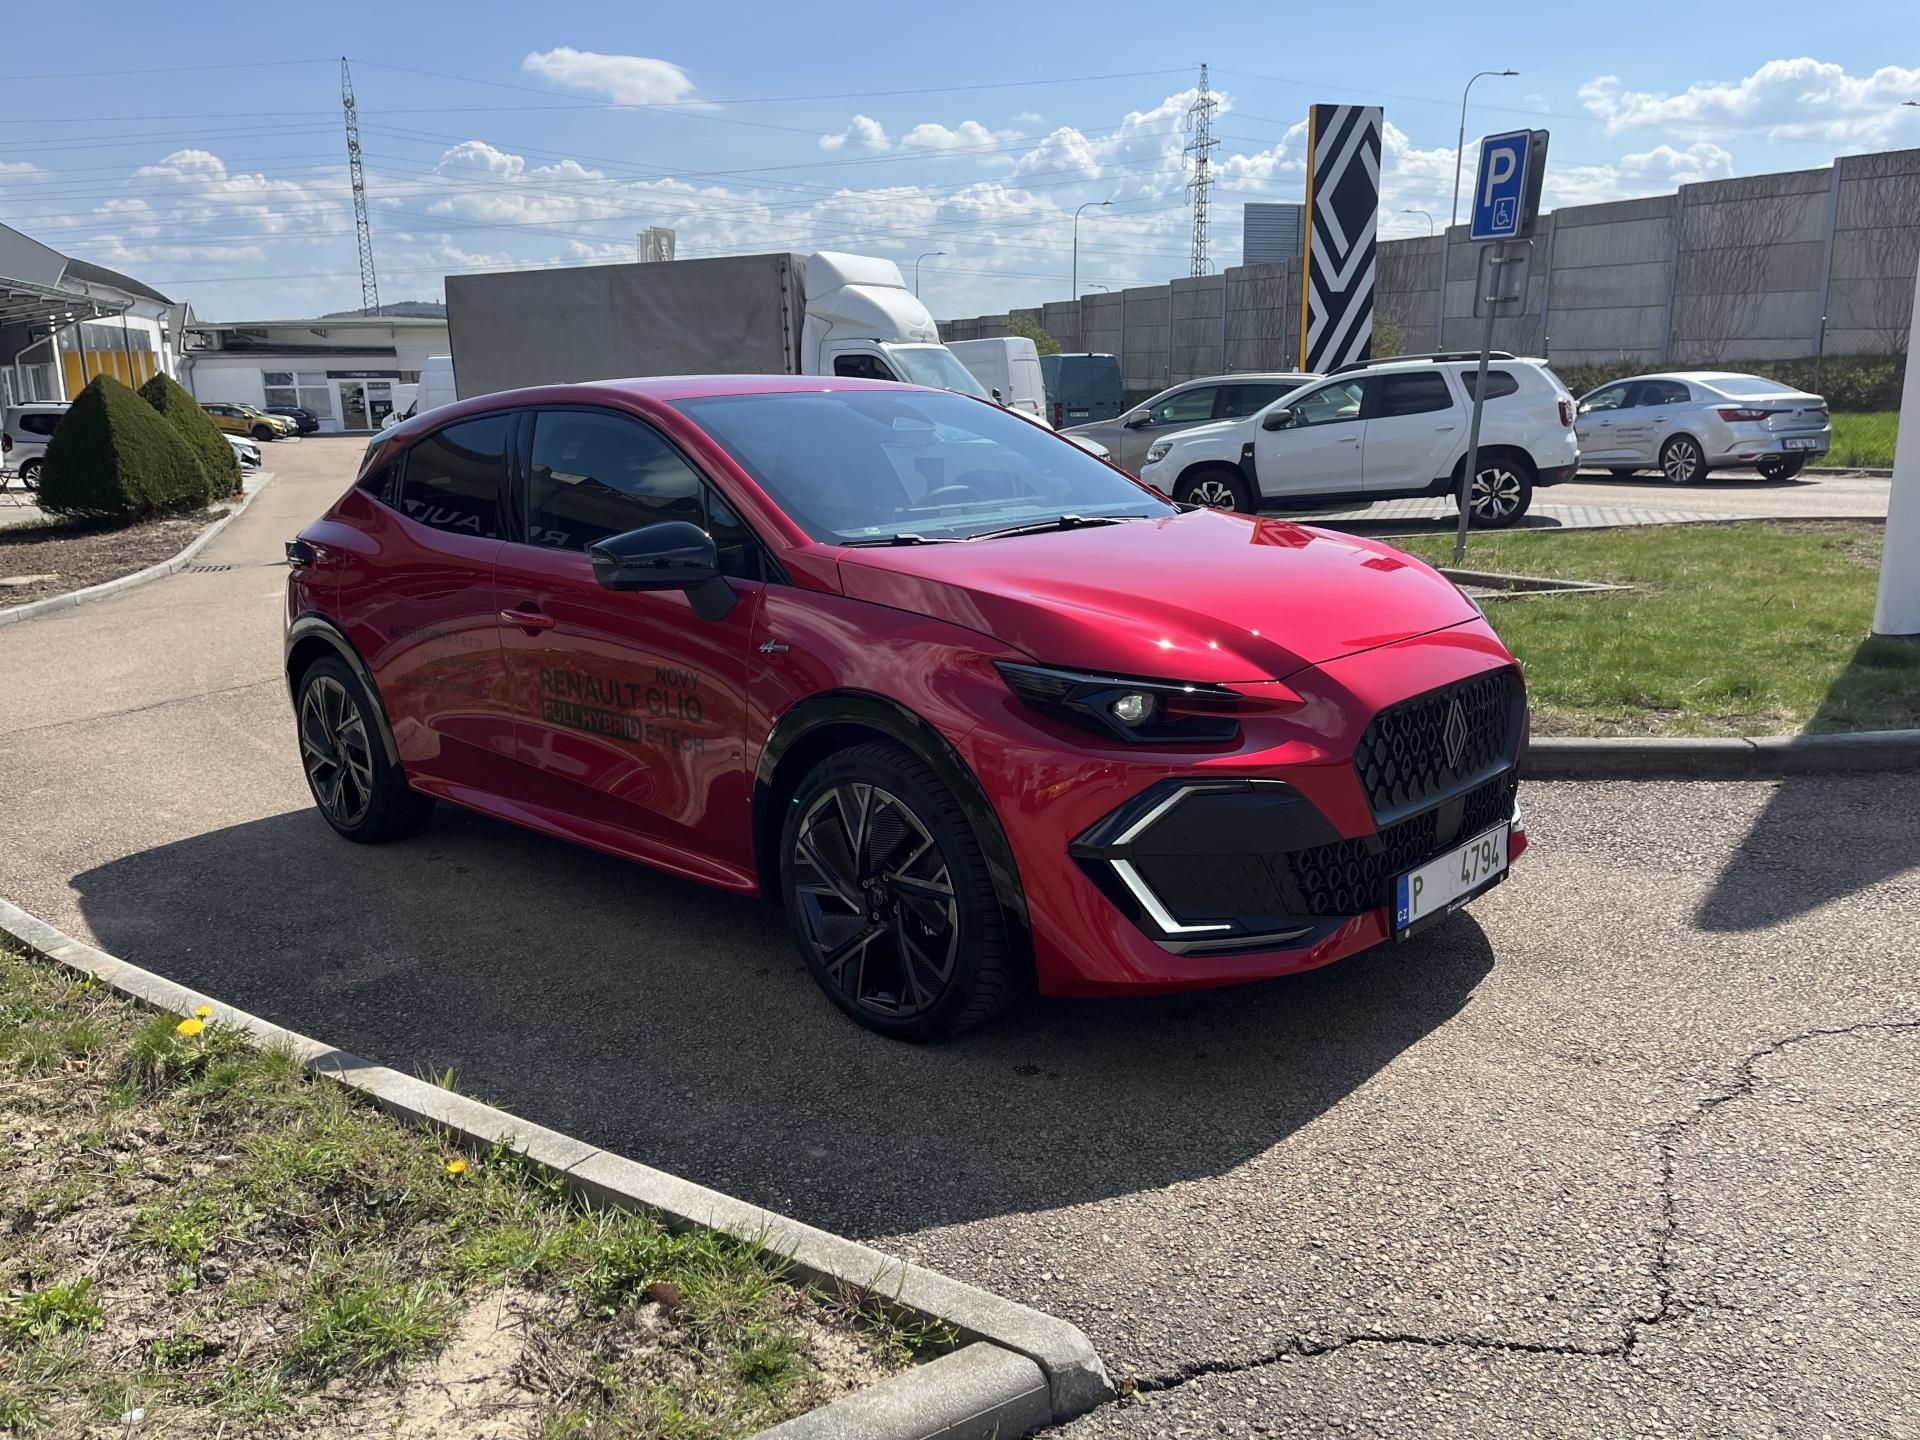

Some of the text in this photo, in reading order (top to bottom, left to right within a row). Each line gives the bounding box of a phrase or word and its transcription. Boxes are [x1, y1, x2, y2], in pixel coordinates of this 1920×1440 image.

[1484, 147, 1517, 207] P
[540, 666, 641, 710] RENAULT
[645, 686, 705, 725] CLIO
[543, 700, 705, 752] FULL HYBRID E-TECH
[1413, 835, 1499, 914] P 4794
[1397, 909, 1408, 922] CZ
